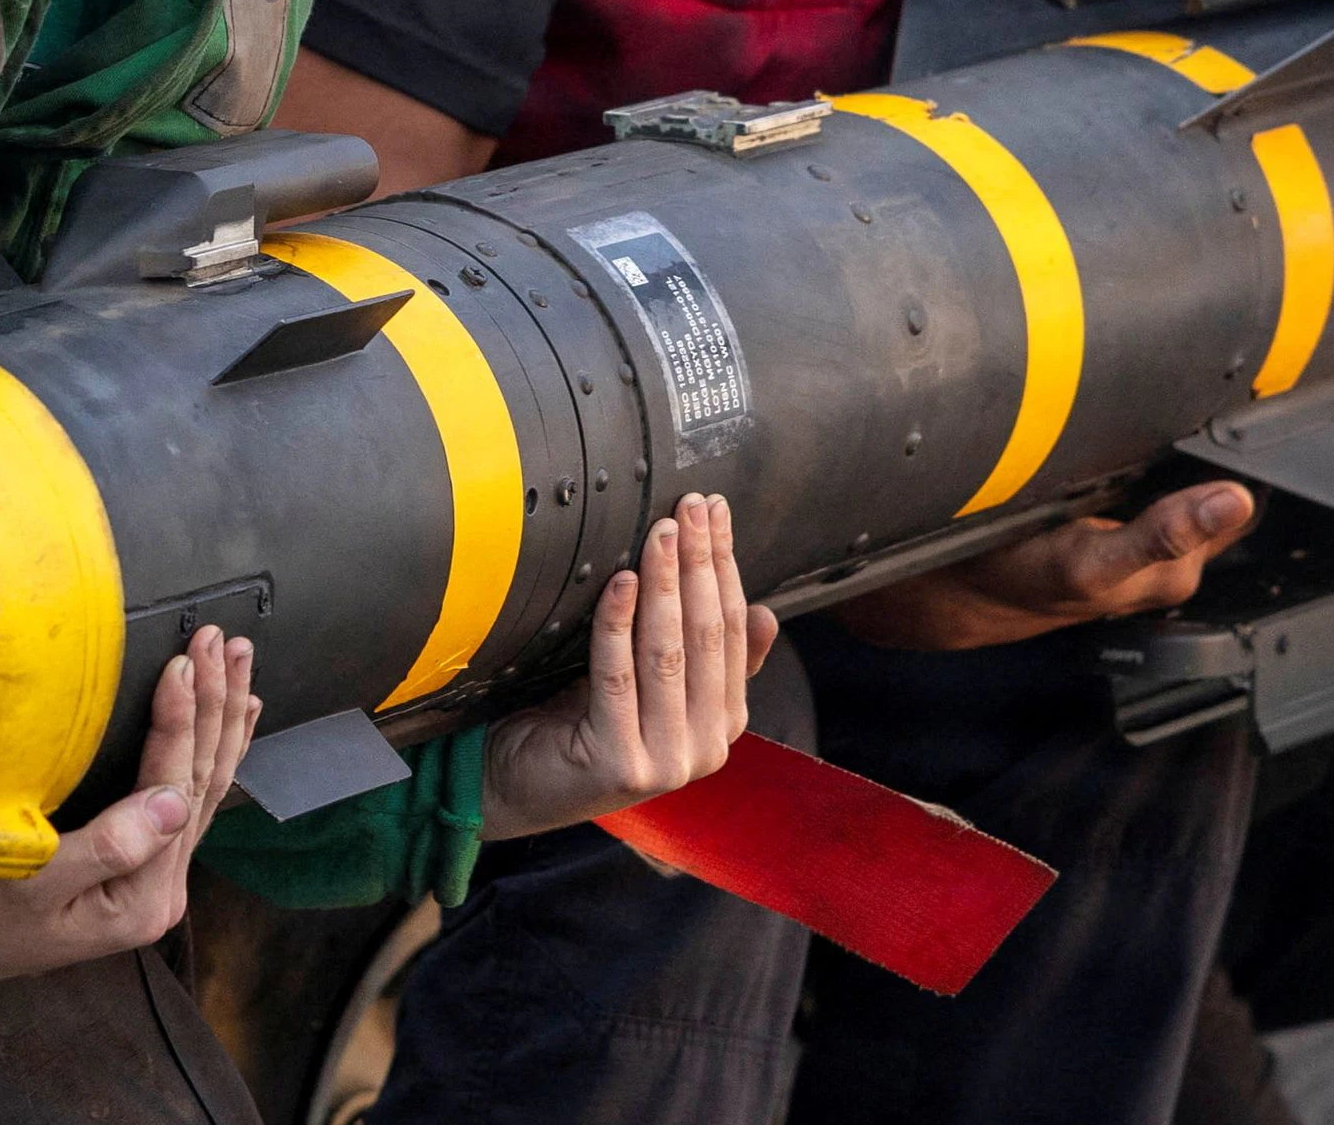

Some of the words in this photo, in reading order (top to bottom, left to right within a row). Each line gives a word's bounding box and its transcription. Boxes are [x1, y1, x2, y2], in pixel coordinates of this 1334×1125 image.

[698, 378, 712, 417] CAGE
[711, 387, 721, 414] LOT
[726, 365, 740, 408] DODIC
[681, 392, 692, 422] PNO
